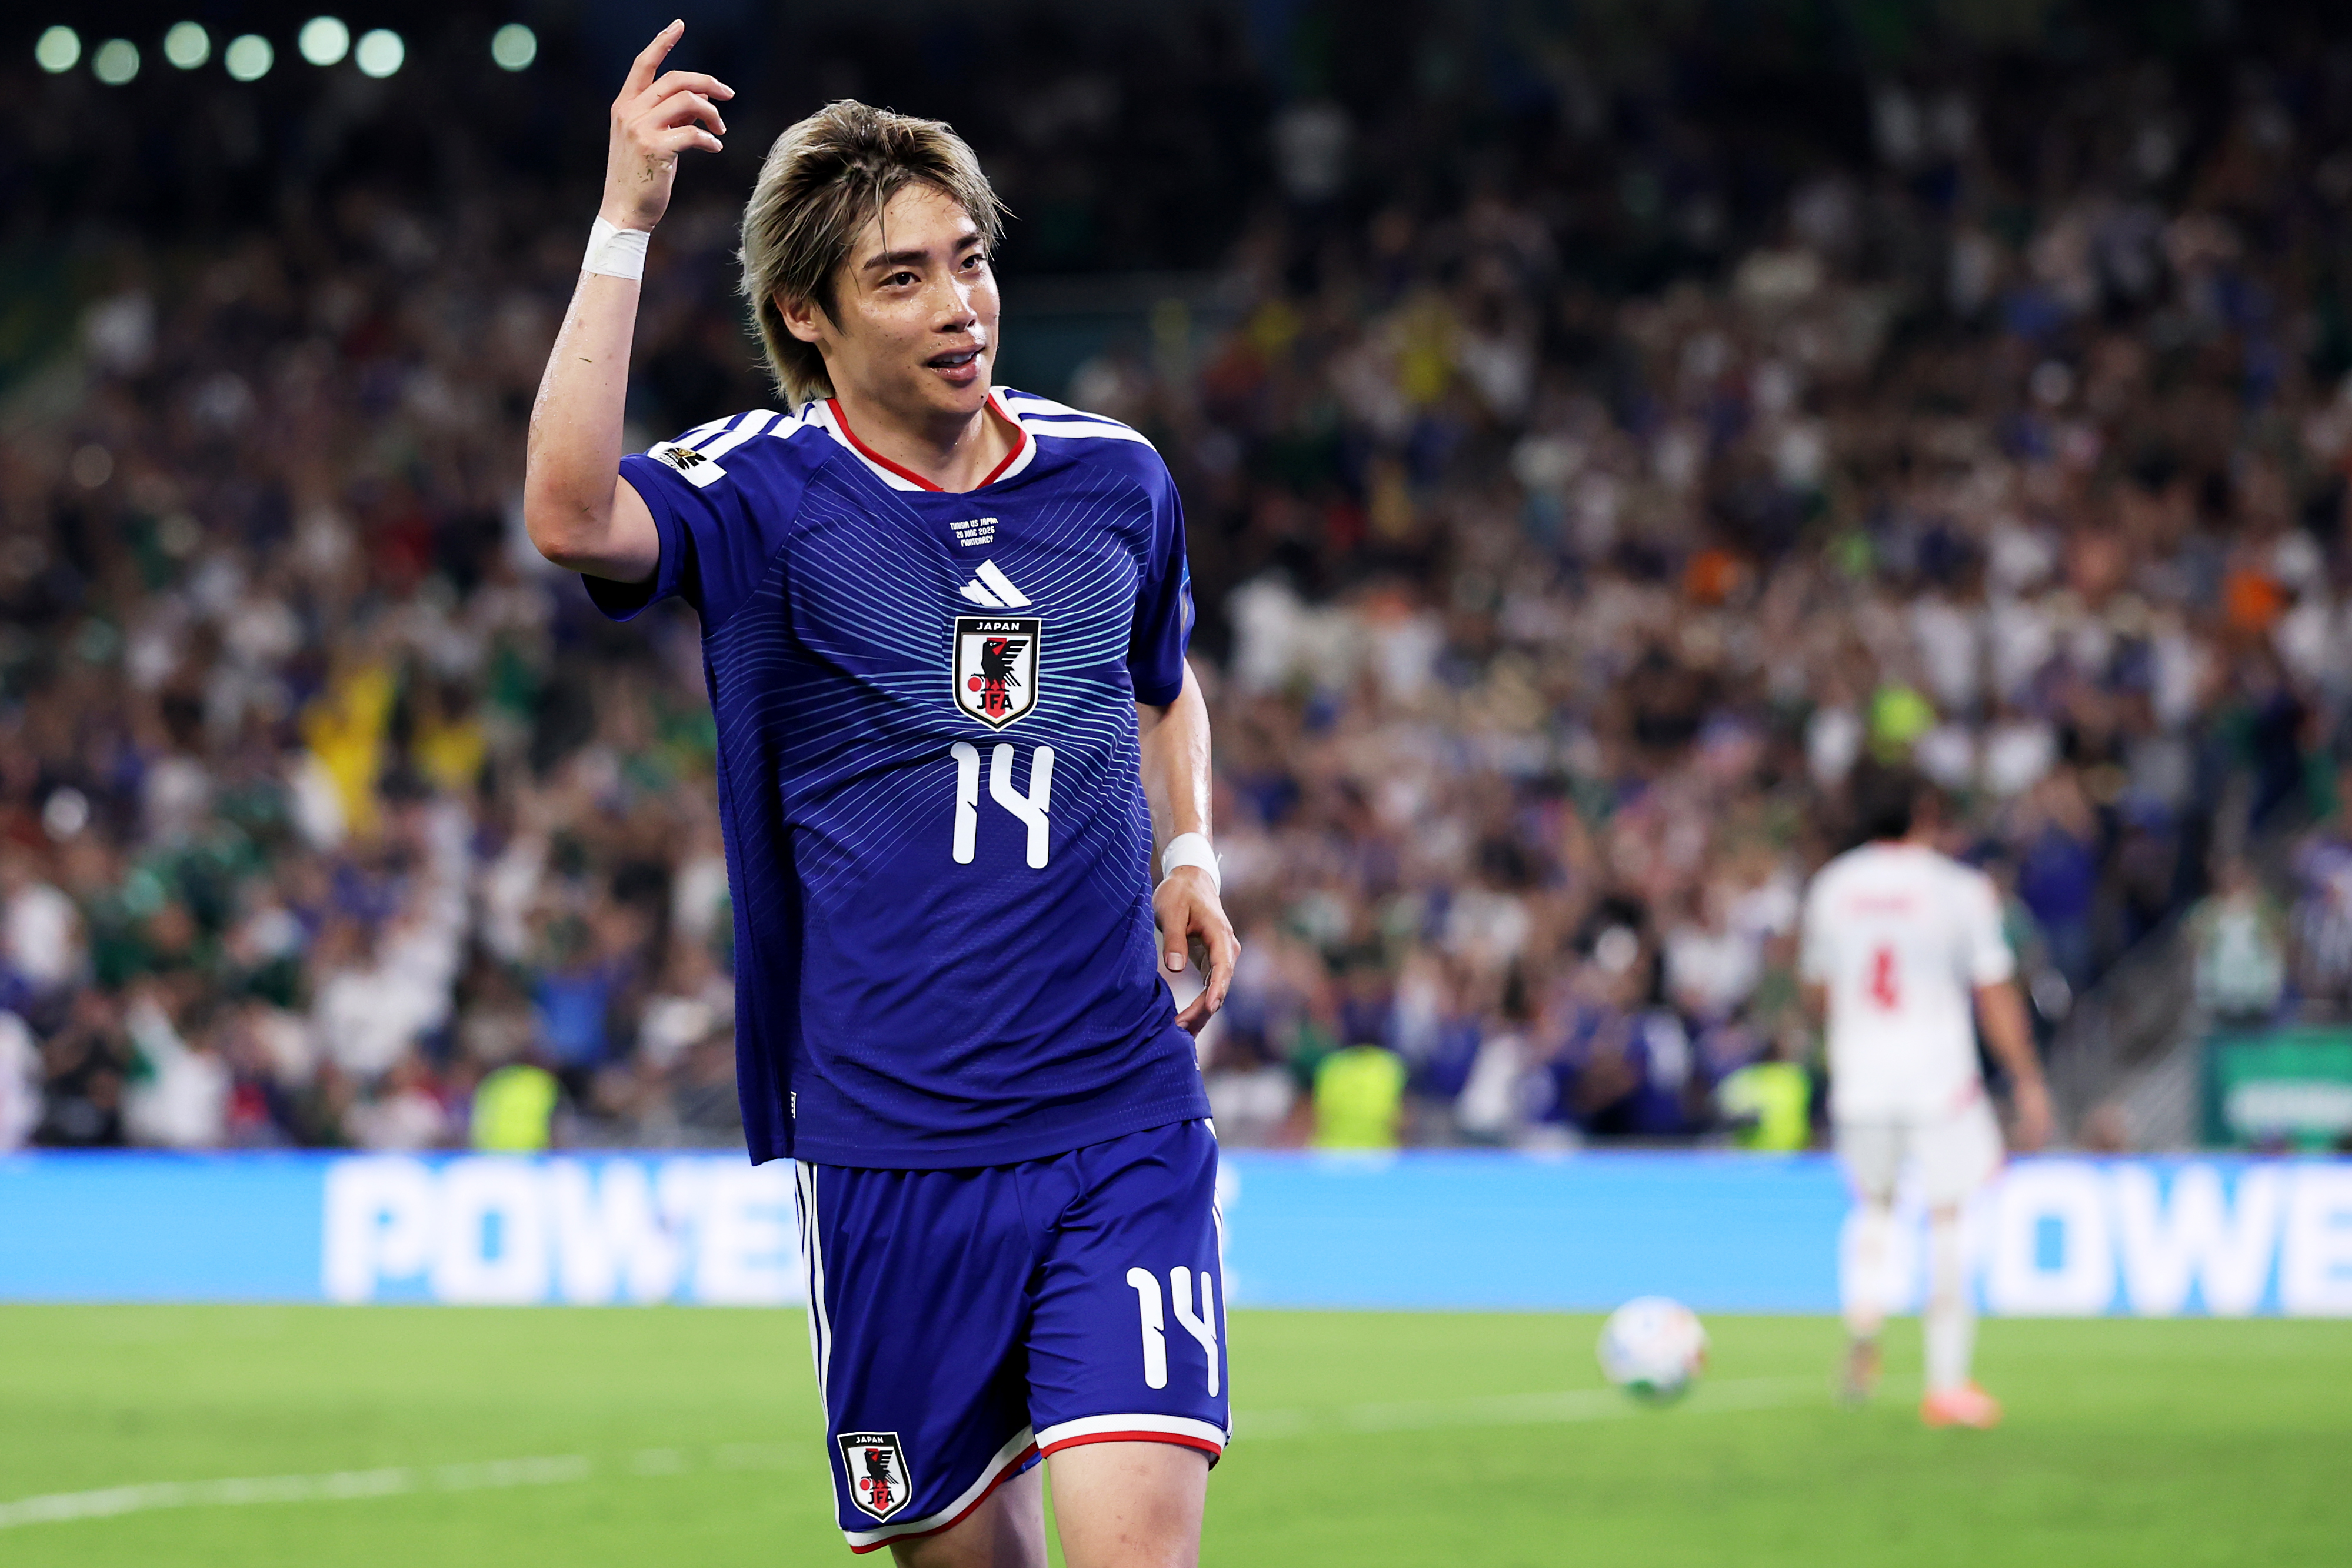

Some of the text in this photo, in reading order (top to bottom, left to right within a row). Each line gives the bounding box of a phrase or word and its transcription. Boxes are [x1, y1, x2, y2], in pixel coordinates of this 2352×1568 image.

[950, 521, 970, 530] TUNISIA
[980, 518, 998, 526] JAPAN
[964, 529, 977, 538] JUNE
[978, 526, 995, 536] 2026
[961, 535, 993, 547] MONTERREY
[976, 622, 1020, 630] JAPAN
[977, 694, 1014, 710] JFA
[950, 741, 1055, 869] 14
[1861, 941, 1905, 1013] 4
[322, 1156, 805, 1304] POWE
[1126, 1266, 1220, 1397] 14
[868, 1490, 895, 1504] JFA
